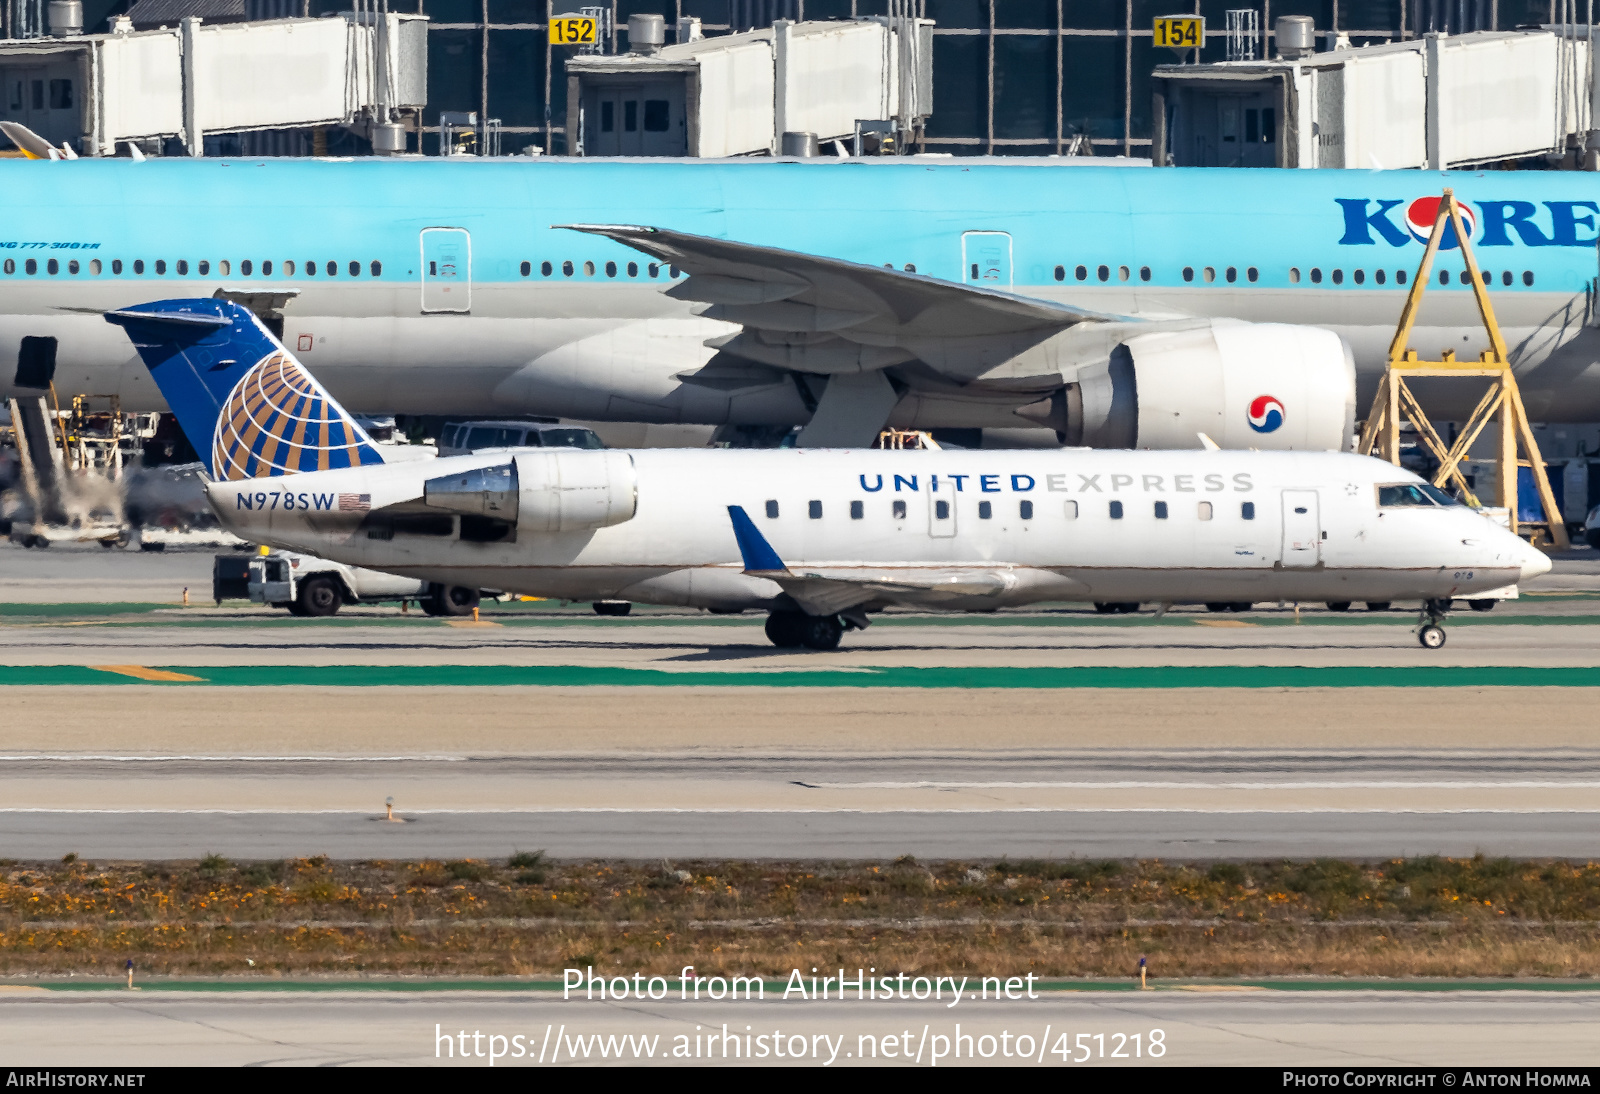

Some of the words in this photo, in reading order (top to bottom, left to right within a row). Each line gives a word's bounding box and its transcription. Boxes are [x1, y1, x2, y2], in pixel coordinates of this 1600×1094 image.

[555, 19, 593, 42] 152
[1158, 21, 1198, 45] 154
[859, 474, 1036, 493] UNITED
[1046, 473, 1254, 493] EXPRESS
[237, 491, 335, 511] N978SW
